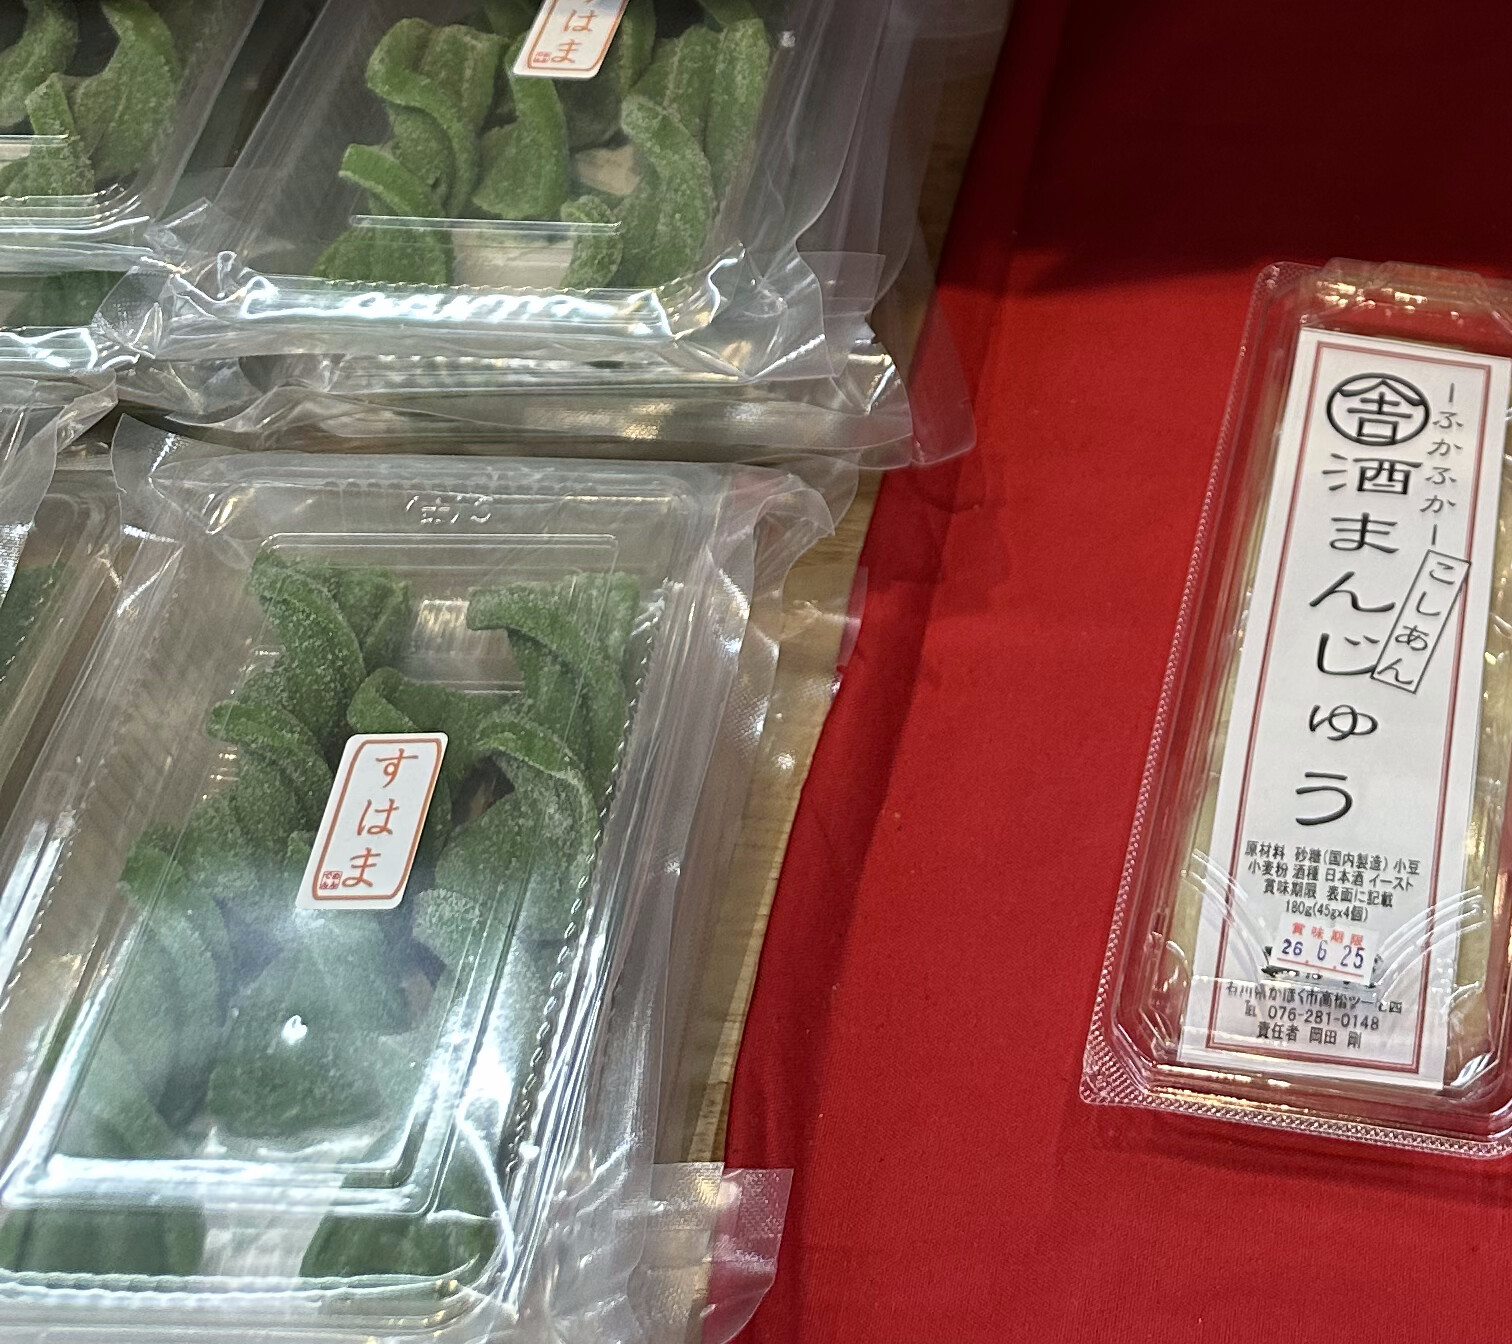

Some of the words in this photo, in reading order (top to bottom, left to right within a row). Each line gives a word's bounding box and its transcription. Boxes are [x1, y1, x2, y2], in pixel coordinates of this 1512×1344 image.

[1377, 560, 1456, 686] こしあん
[1295, 452, 1424, 826] 酒まんじゅう
[341, 747, 419, 888] すはま
[1247, 860, 1289, 879] 小麦粉
[1324, 867, 1365, 887] 日本酒
[1368, 873, 1414, 891] イースト
[1393, 858, 1421, 876] 小豆
[1263, 877, 1318, 900] 賞味期限
[1281, 938, 1304, 956] 26
[1316, 939, 1329, 962] 6
[1340, 944, 1366, 969] 25
[1267, 1005, 1380, 1031] 076-281-0148
